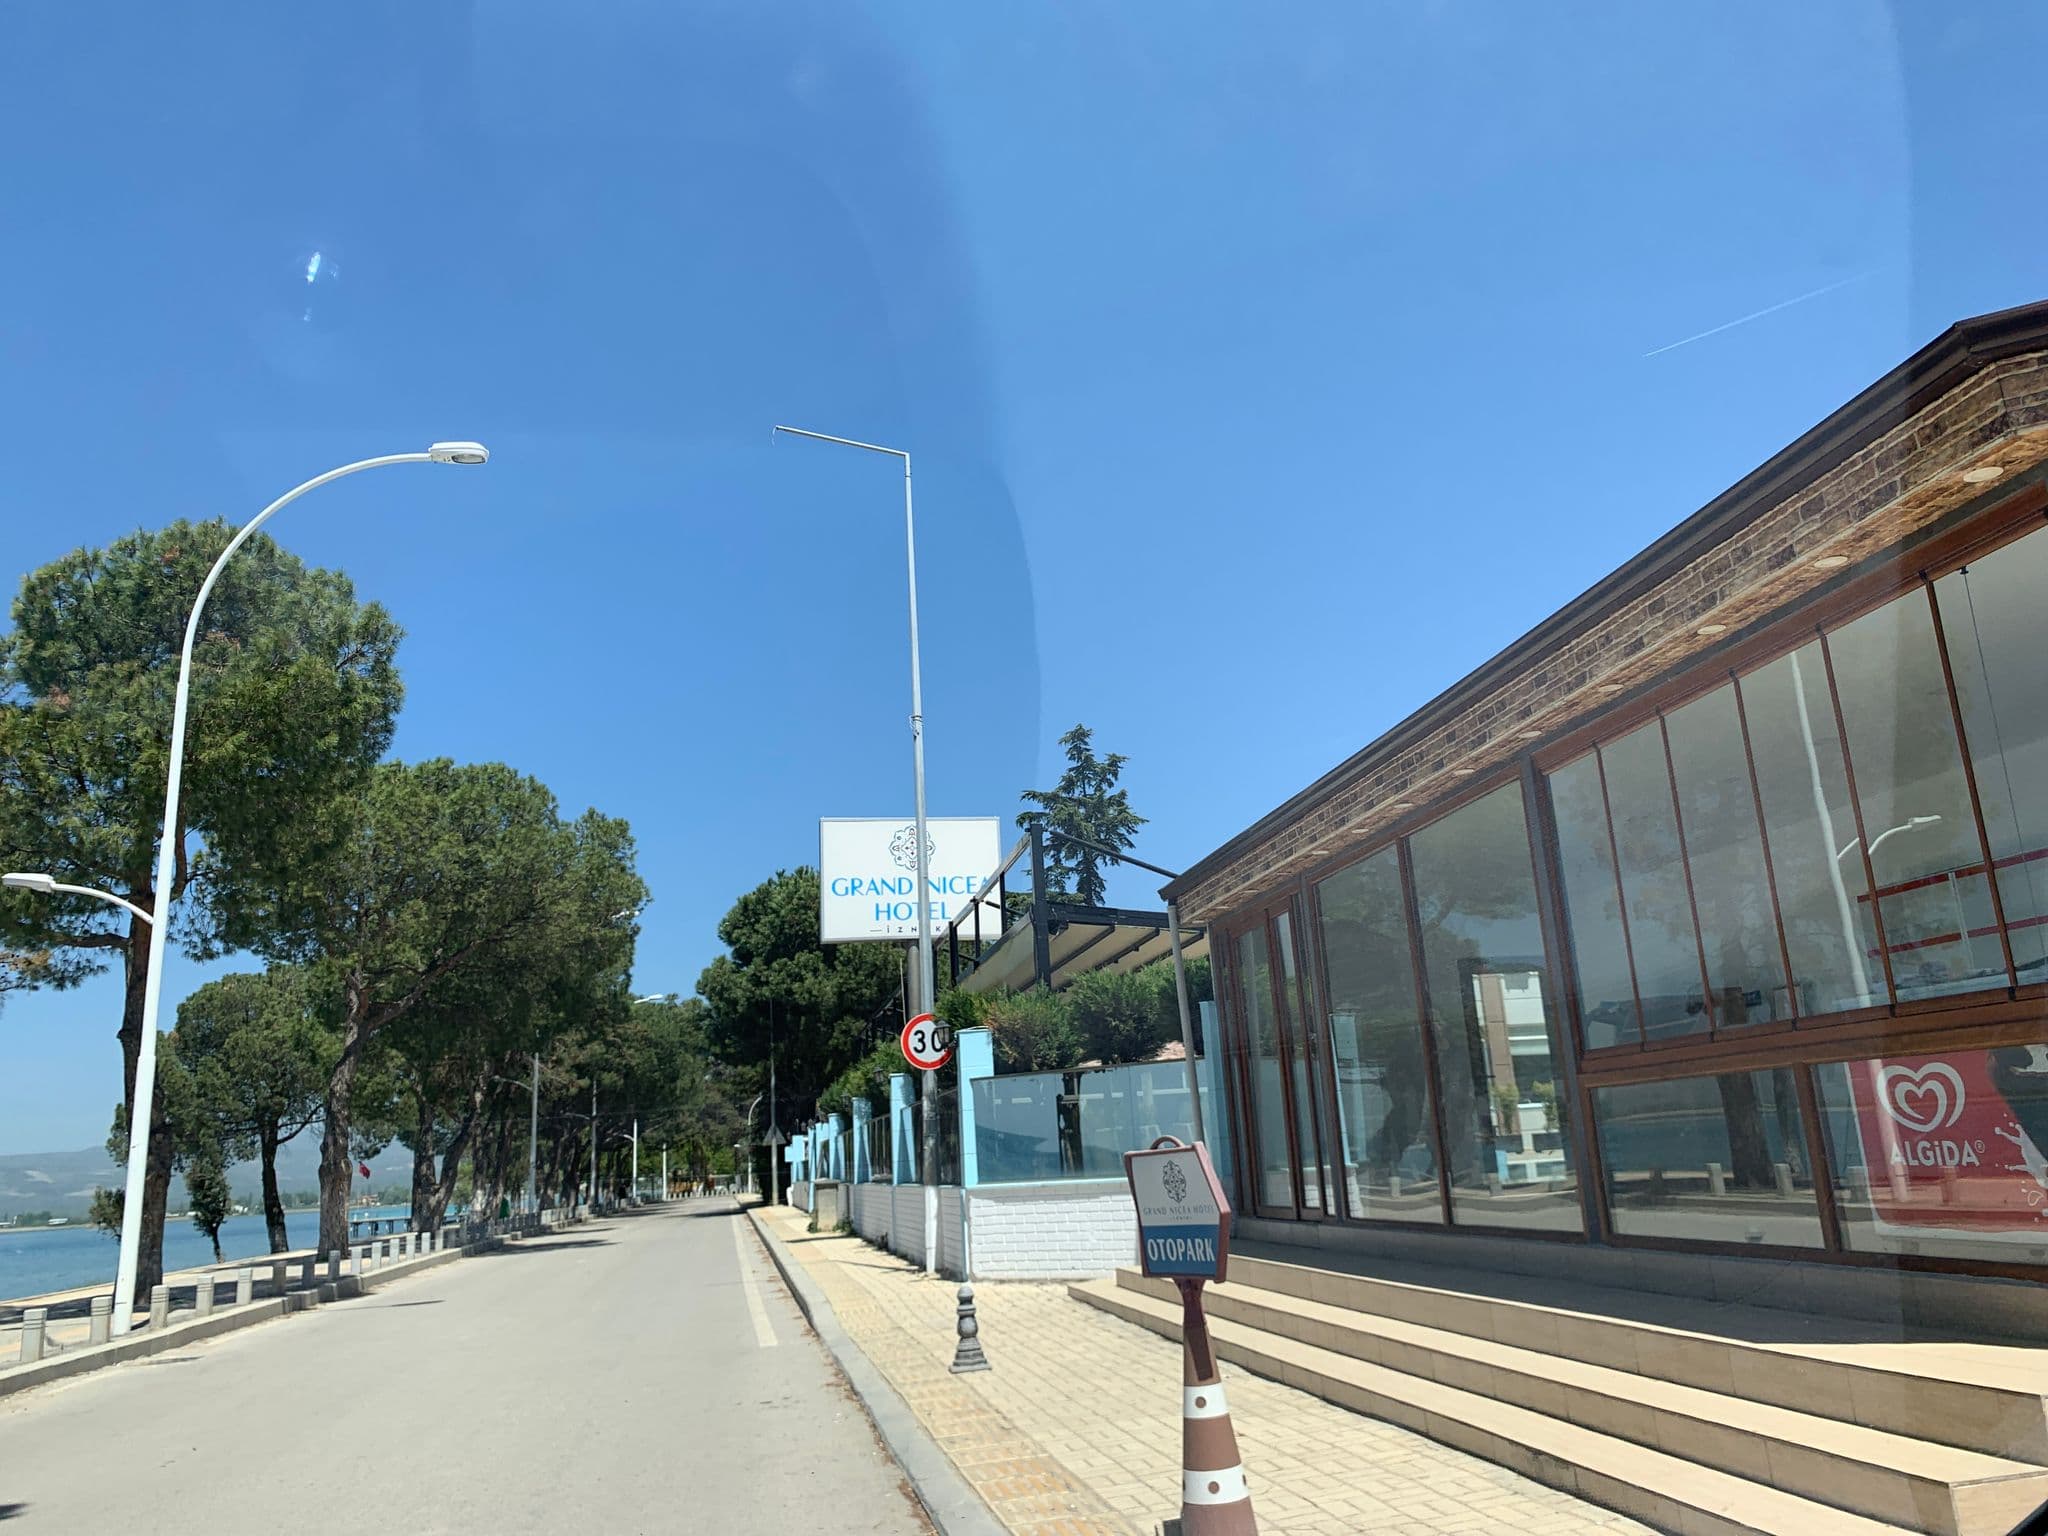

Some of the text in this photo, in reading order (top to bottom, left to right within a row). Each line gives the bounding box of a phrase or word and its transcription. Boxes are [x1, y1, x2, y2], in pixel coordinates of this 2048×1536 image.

[831, 877, 913, 897] GRAND
[886, 924, 942, 934] İZNK
[913, 1029, 945, 1053] 30
[1147, 1238, 1216, 1262] OTOPARK
